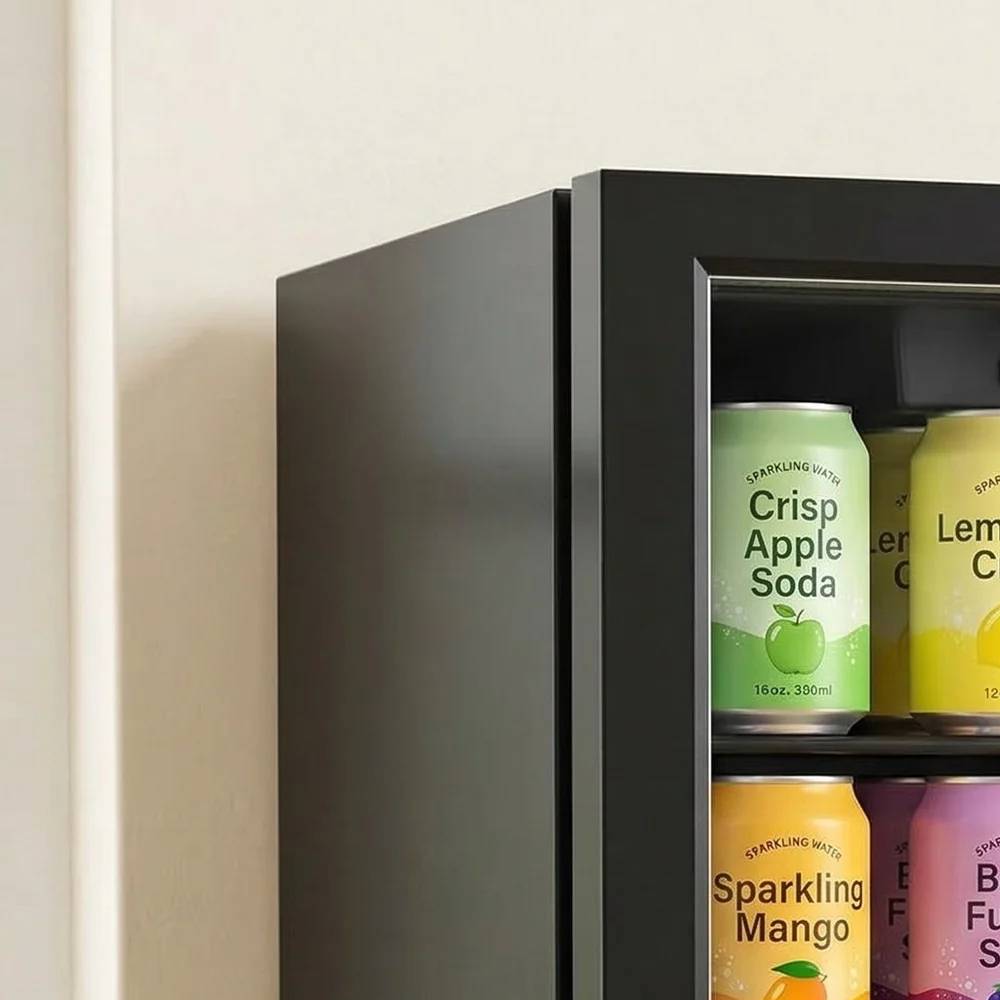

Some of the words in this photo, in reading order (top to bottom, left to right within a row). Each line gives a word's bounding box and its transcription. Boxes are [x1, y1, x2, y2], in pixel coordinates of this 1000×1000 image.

[745, 461, 810, 485] SPARKLING
[749, 489, 838, 529] Crisp
[744, 530, 842, 567] Apple
[751, 567, 836, 598] Soda
[744, 836, 809, 860] SPARKLING
[713, 872, 864, 910] Sparkling
[736, 912, 849, 950] Mango
